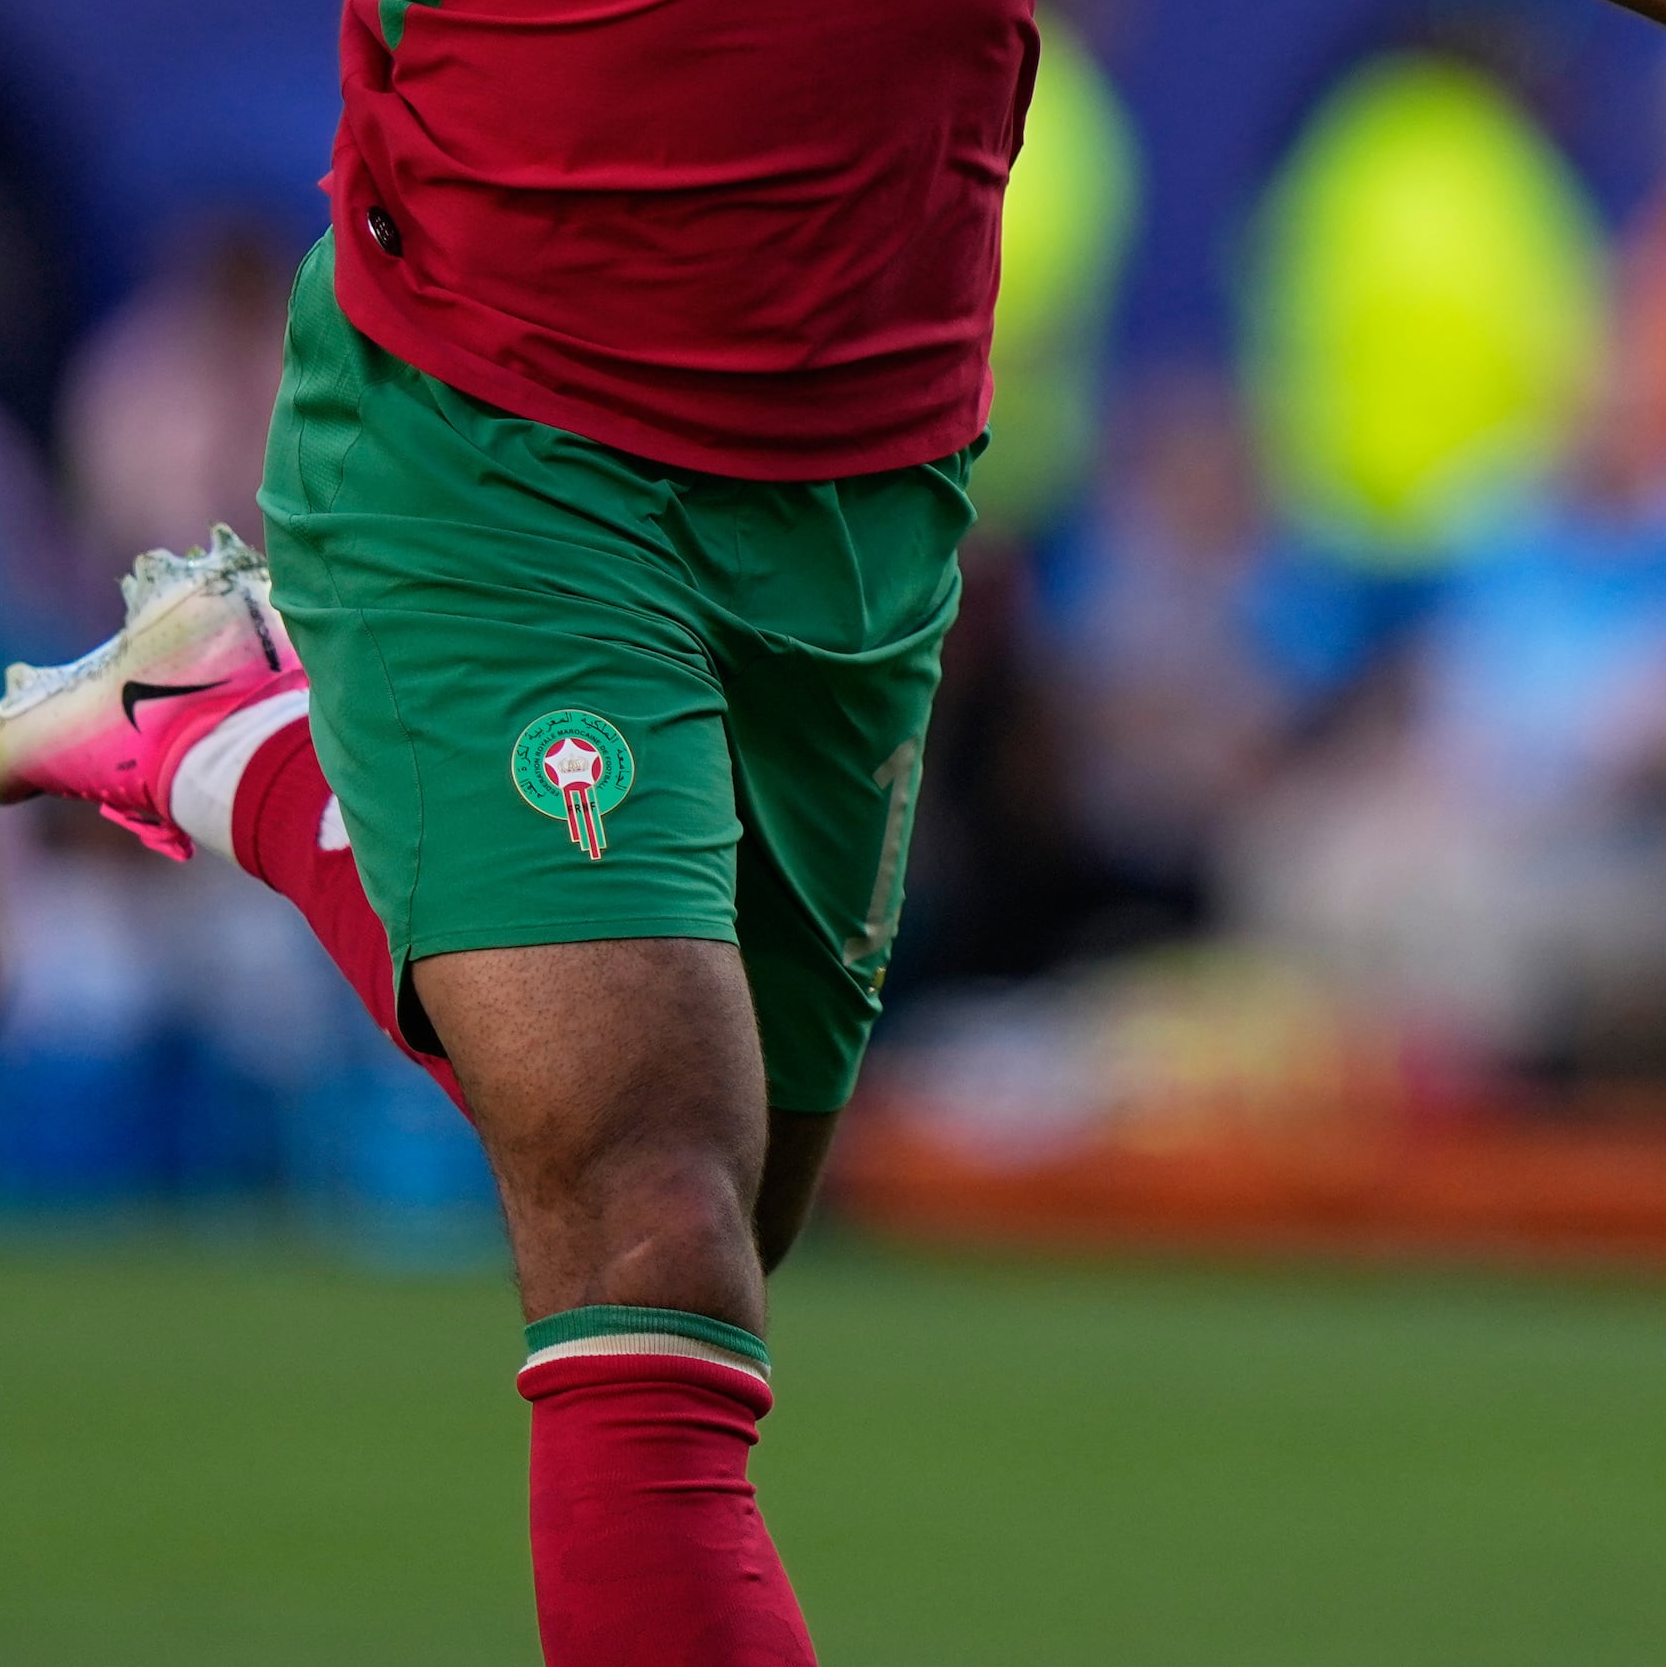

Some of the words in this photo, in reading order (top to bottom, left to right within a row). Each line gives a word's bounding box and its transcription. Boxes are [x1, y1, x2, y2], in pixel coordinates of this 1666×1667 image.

[535, 734, 555, 757] ROYALE
[557, 728, 602, 747] MAROCAINE
[599, 745, 608, 756] DE
[597, 756, 612, 790] FOOTBALL
